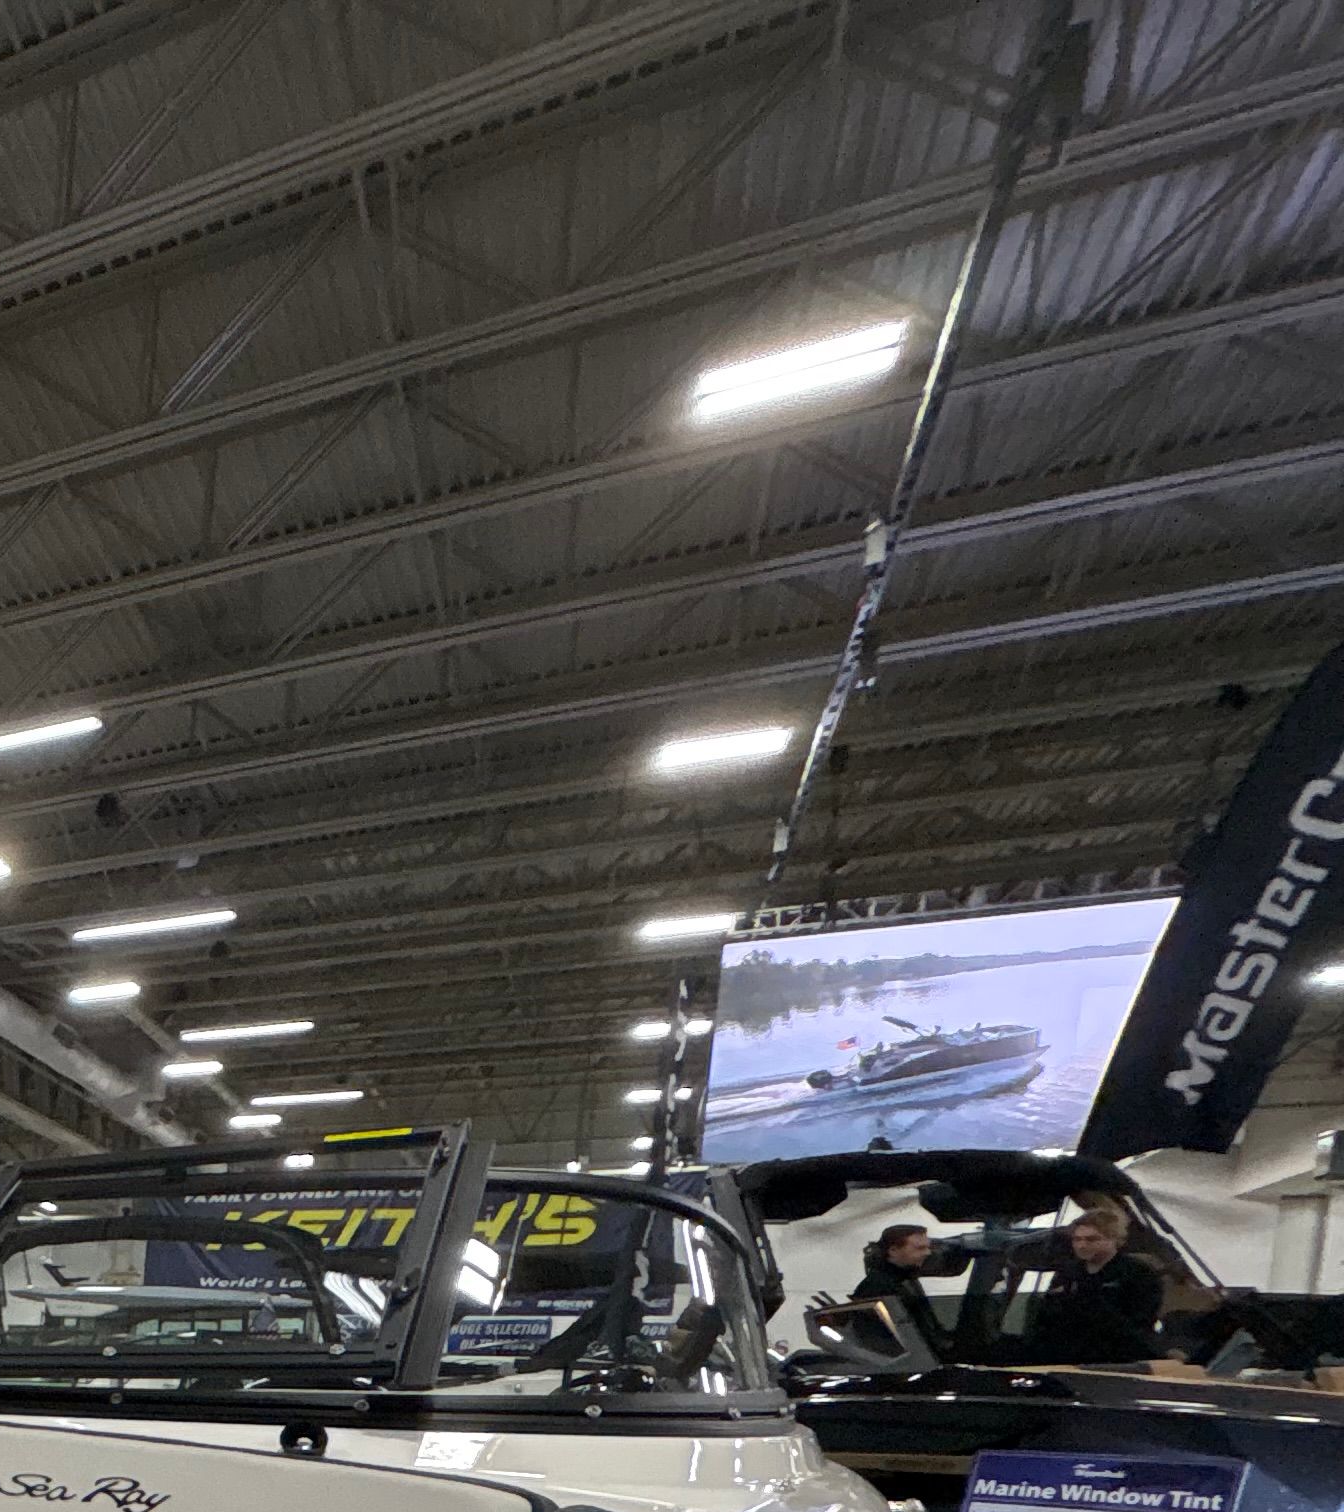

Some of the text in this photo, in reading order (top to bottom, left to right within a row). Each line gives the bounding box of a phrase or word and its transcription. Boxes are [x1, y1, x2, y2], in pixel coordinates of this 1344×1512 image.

[198, 1275, 274, 1290] World's
[973, 1478, 1225, 1511] Marine Window Tint
